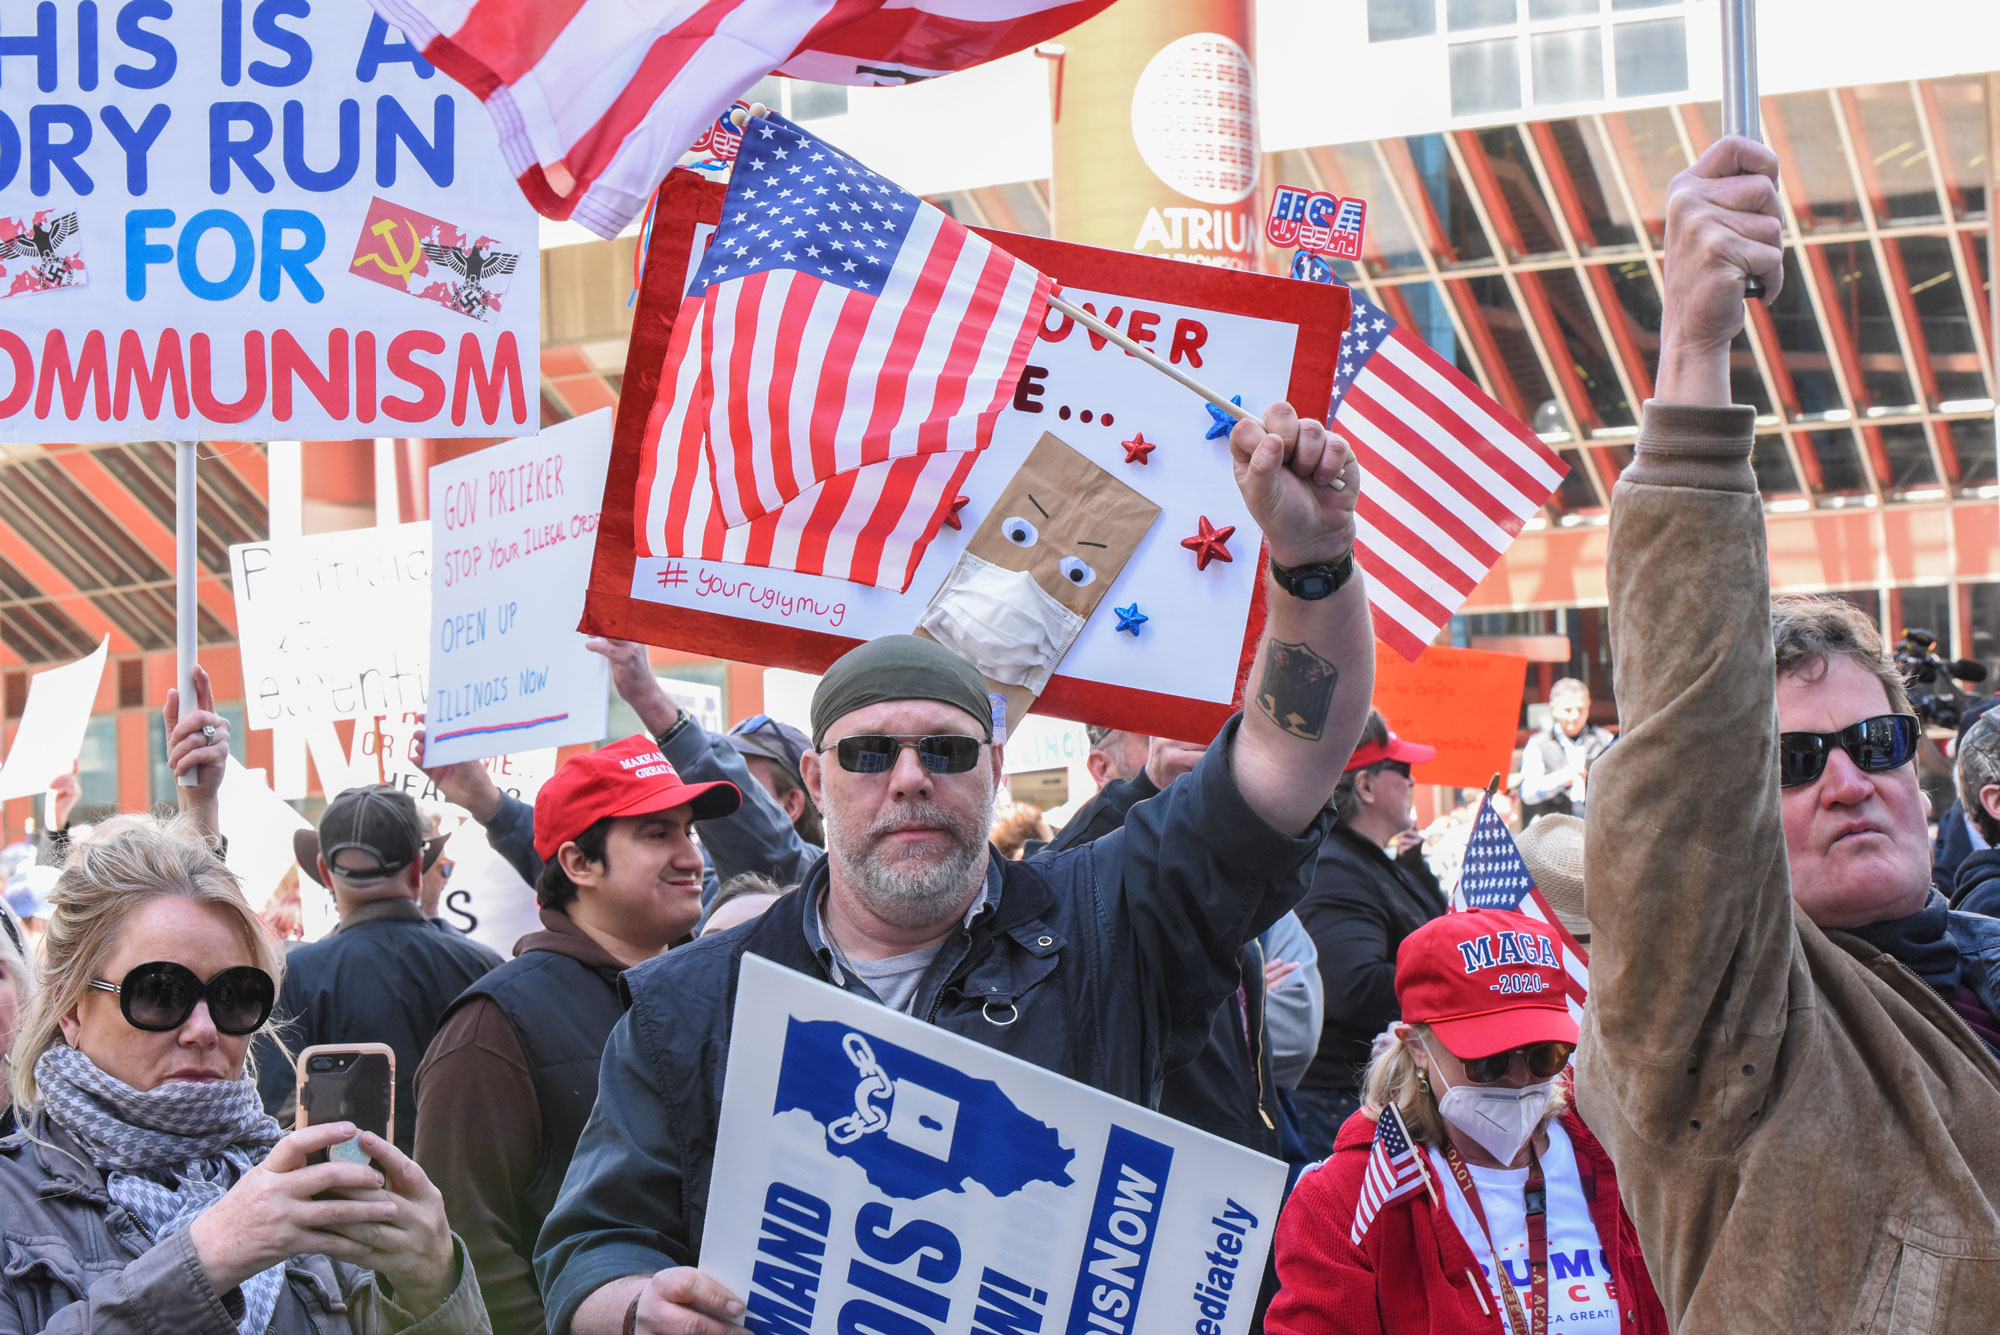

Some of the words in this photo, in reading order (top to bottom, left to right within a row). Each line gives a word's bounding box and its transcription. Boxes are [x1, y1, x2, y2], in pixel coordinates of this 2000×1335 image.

[220, 0, 313, 88] IS
[355, 0, 436, 83] A
[0, 104, 172, 197] RY
[209, 94, 455, 194] RUN
[1267, 187, 1361, 257] USA
[125, 208, 326, 304] FOR
[1037, 302, 1208, 369] OVER
[444, 477, 478, 531] GOV
[489, 454, 564, 518] PRITZKER
[444, 545, 482, 588] STOP
[488, 538, 520, 570] YOUR
[523, 521, 566, 556] ILLEGAL
[441, 607, 487, 653] OPEN
[498, 601, 518, 635] UP
[436, 676, 508, 723] ILLINOIS
[519, 665, 549, 697] NOW
[1457, 930, 1560, 974] MAGA
[1489, 973, 1550, 994] -2020-
